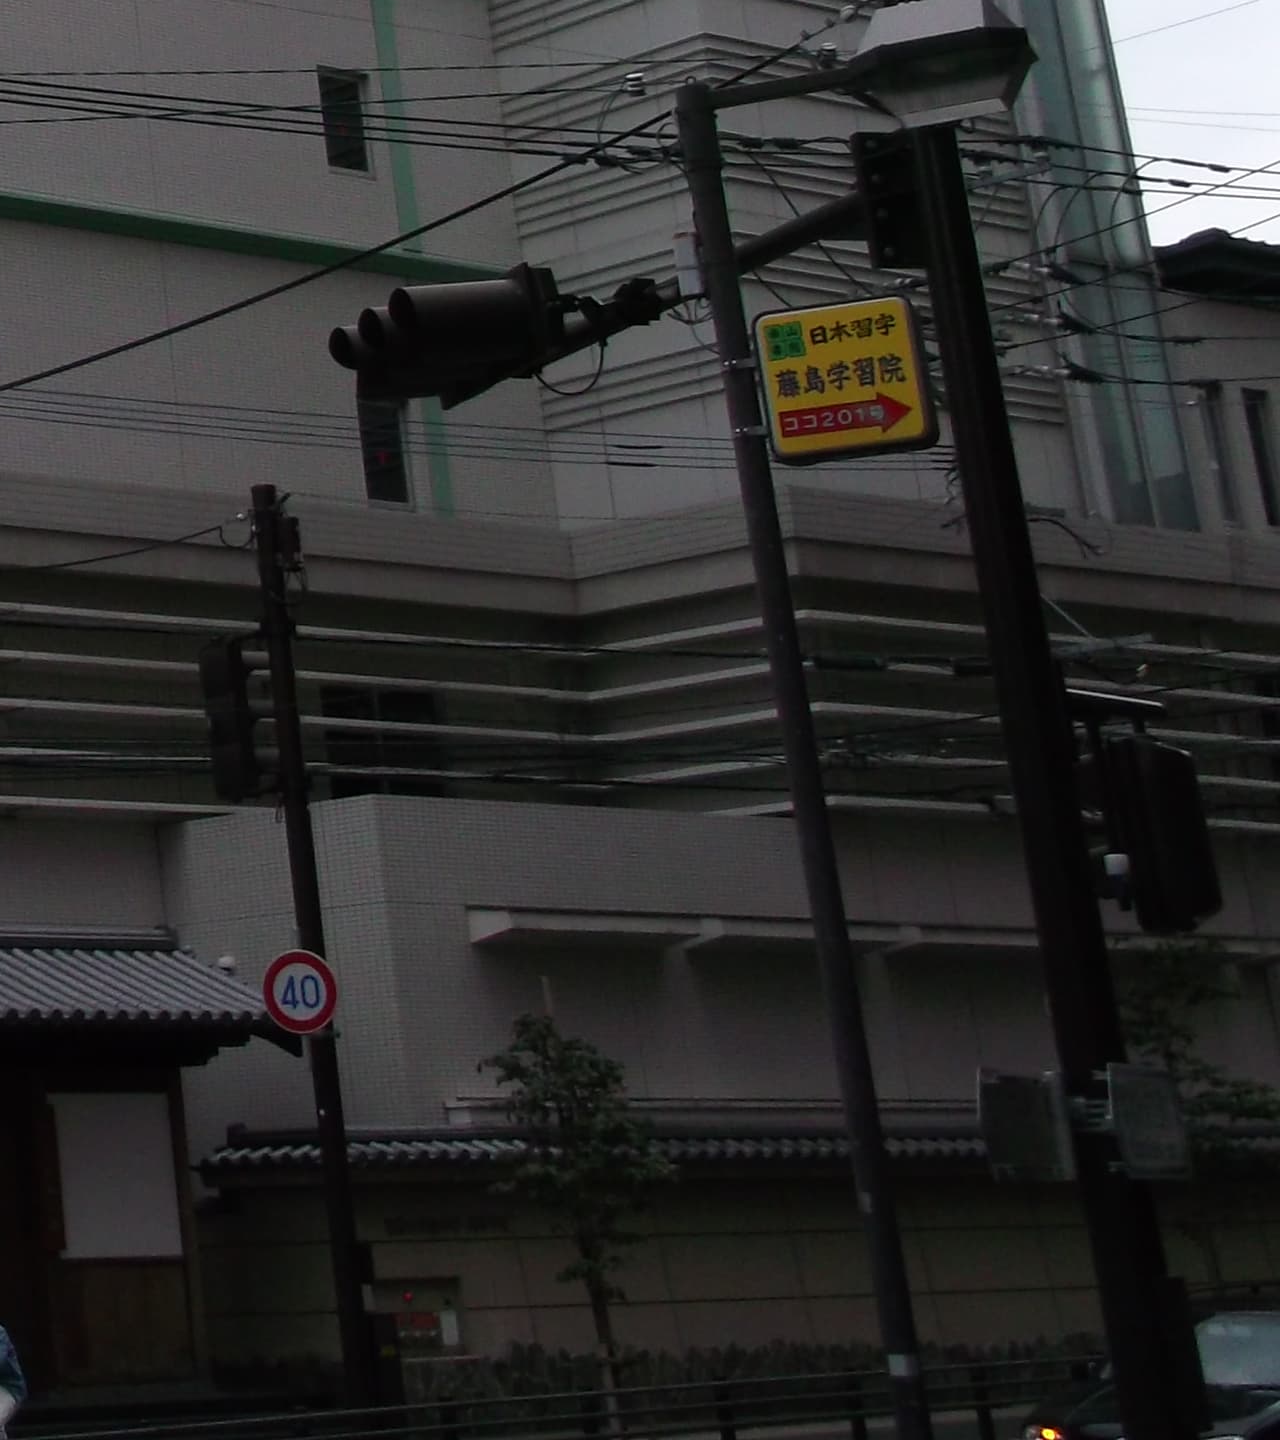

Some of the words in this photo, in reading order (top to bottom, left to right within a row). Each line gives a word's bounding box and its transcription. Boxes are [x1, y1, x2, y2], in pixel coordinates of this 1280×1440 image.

[809, 313, 896, 345] 日本習字
[775, 354, 907, 398] 藤島学習院
[281, 974, 320, 1009] 40
